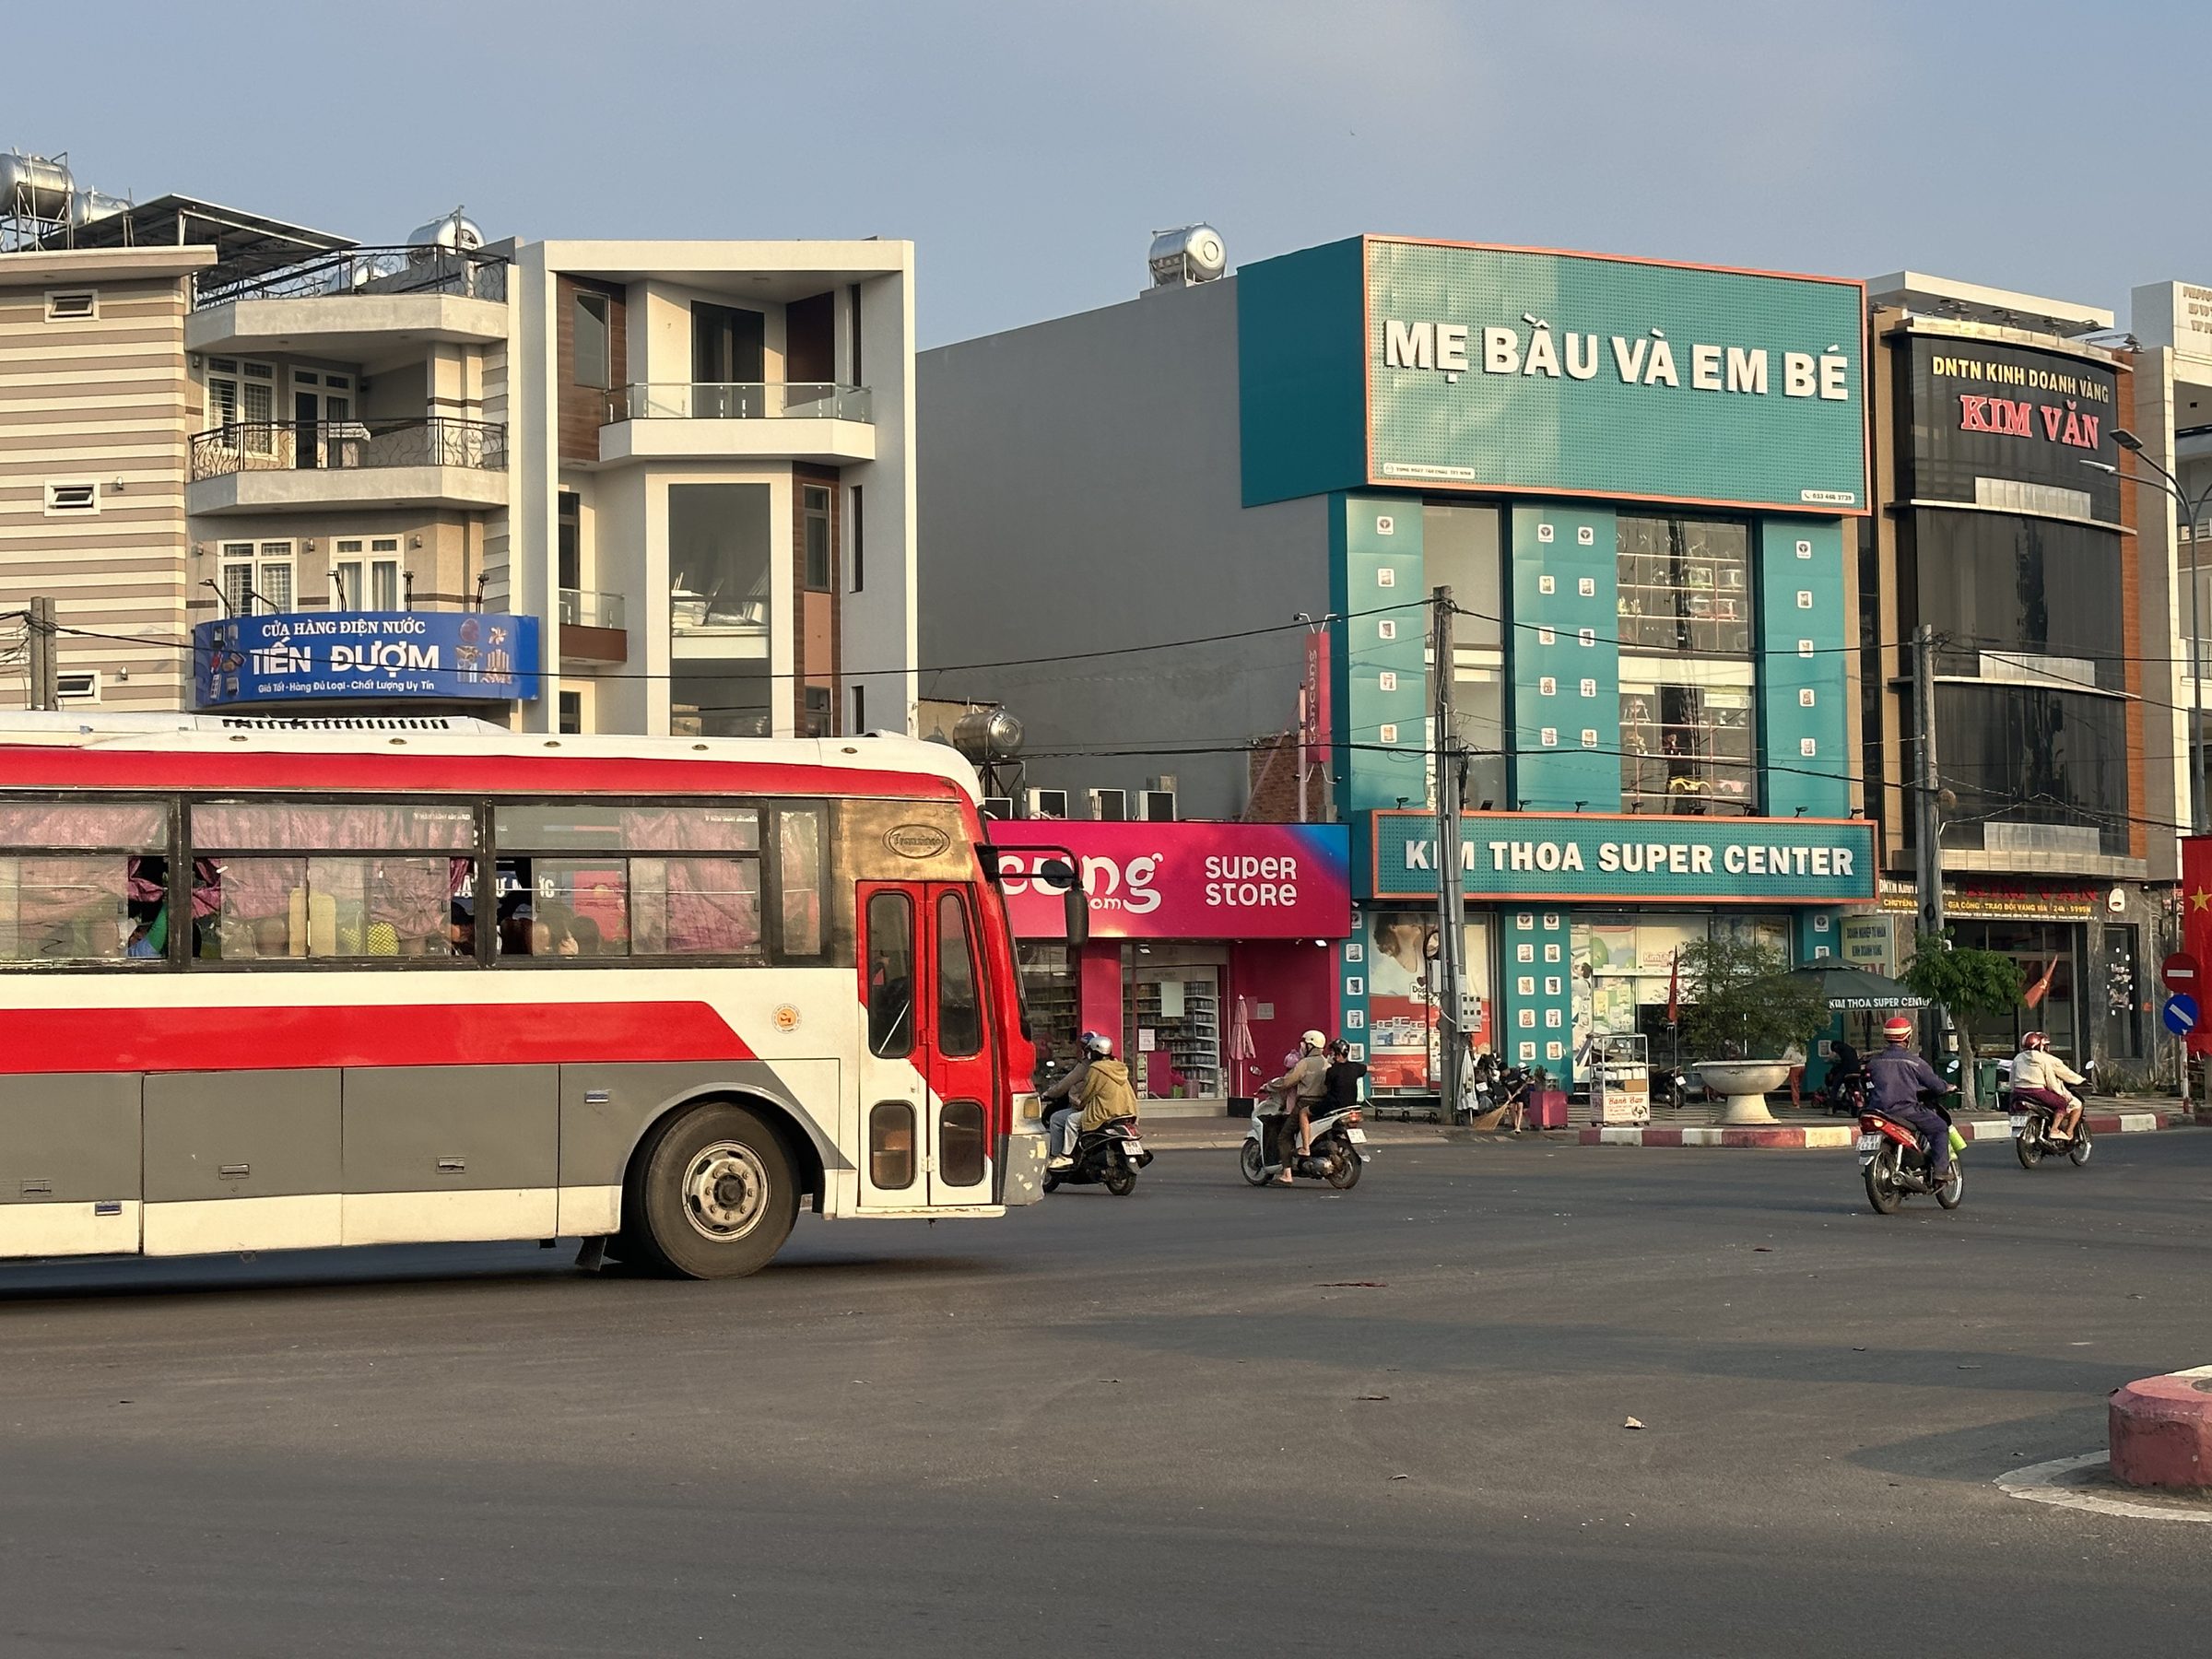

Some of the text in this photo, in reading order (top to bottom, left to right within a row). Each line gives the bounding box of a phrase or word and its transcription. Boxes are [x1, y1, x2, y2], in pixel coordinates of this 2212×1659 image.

[1383, 312, 1849, 401] MẸ BẦU VÀ EM BÉ
[1932, 356, 2109, 404] DNTN KINH DOANH VÀNG
[1959, 394, 2100, 451] KIM VĂN
[262, 617, 427, 638] CỬA HÀNG ĐIỆN NƯỚC
[249, 636, 441, 678] TIẾN ĐƯỢM
[289, 682, 312, 693] Hàng
[351, 679, 374, 690] Chất
[1488, 841, 1584, 872] THOA
[1598, 843, 1713, 875] SUPER
[1724, 845, 1854, 877] CENTER
[1848, 998, 1872, 1008] THOA
[1874, 997, 1899, 1007] SUPER
